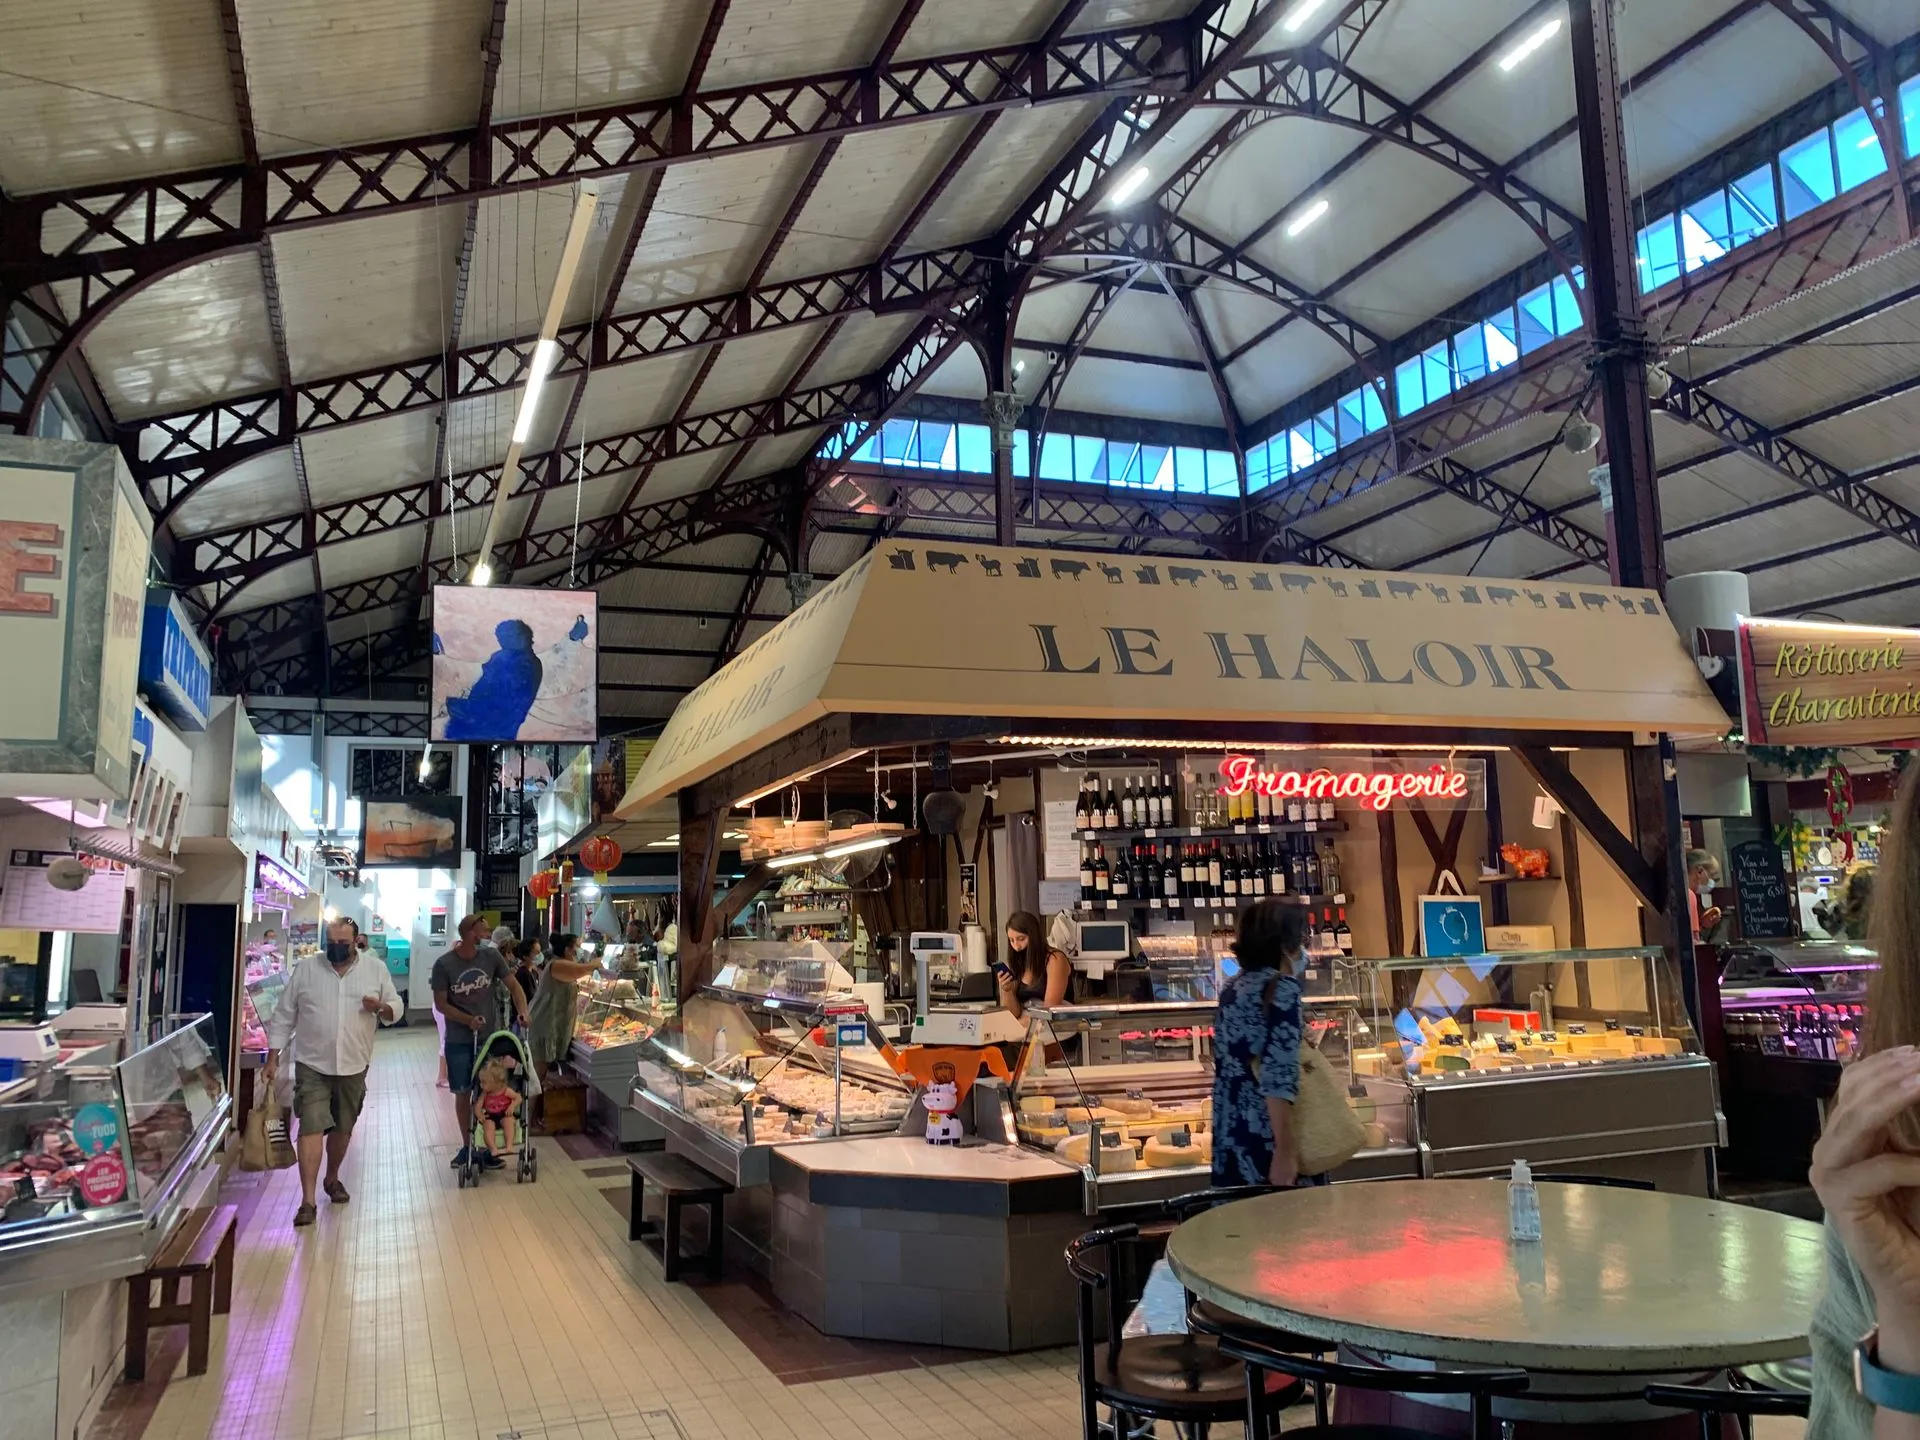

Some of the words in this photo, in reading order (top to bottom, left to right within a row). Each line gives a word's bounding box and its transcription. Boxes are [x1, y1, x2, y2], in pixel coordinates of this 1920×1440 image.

[1029, 623, 1174, 675] LE
[1204, 631, 1571, 691] HALOIR
[1775, 639, 1904, 678] Rôtisserie
[658, 726, 693, 773] LE
[684, 665, 785, 755] HALOIR
[1225, 755, 1468, 811] Fromagerie
